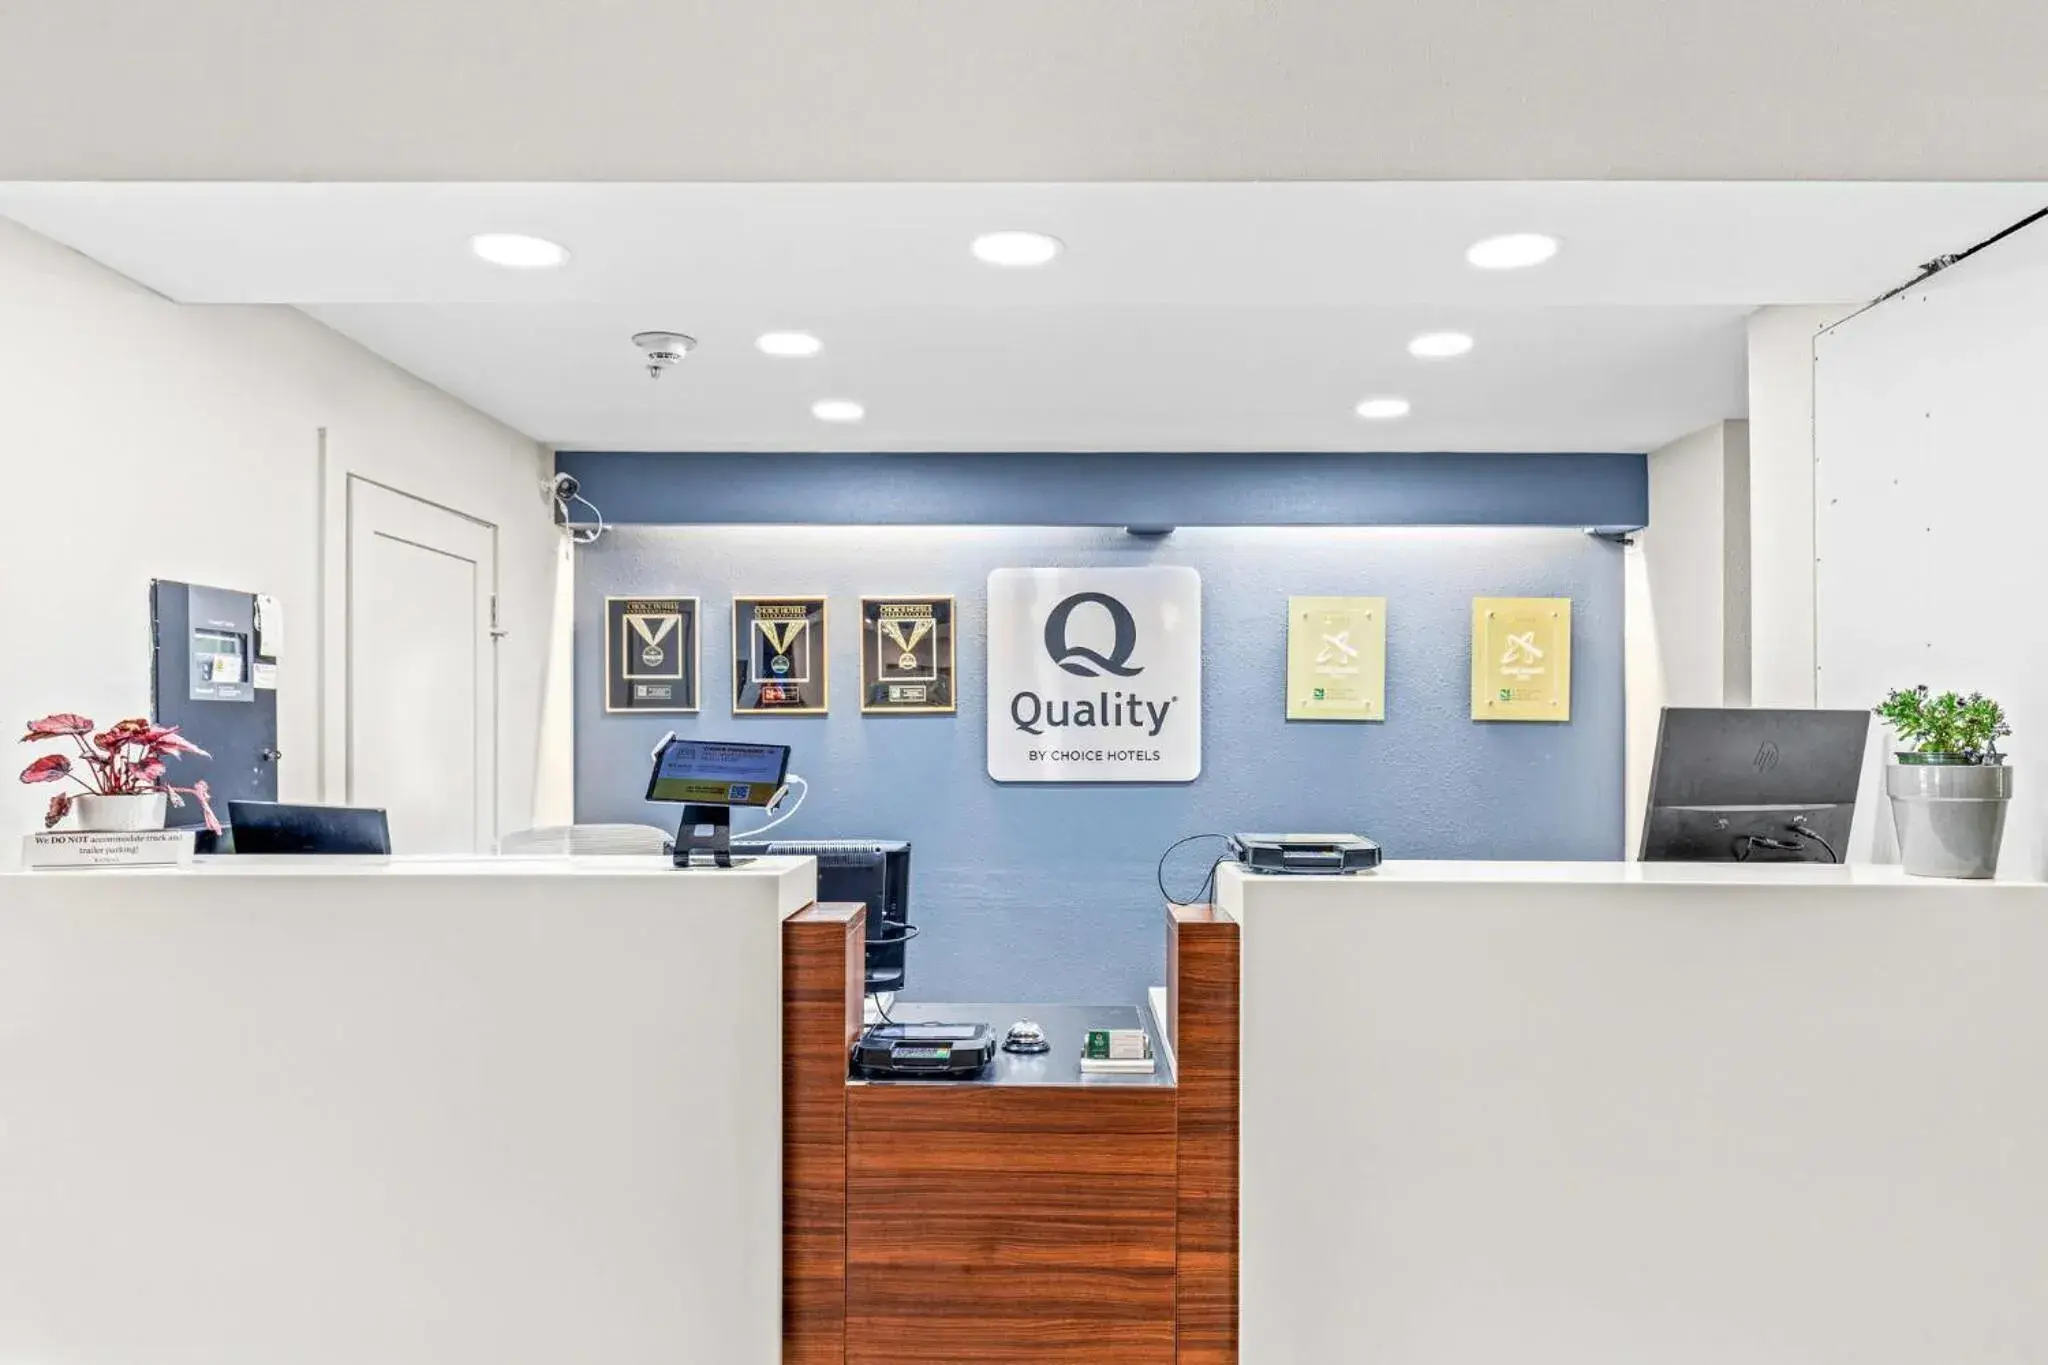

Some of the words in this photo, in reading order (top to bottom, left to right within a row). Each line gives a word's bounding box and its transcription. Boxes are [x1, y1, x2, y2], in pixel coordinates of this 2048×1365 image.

[1044, 592, 1145, 677] Q
[1011, 691, 1170, 737] Quality
[1029, 750, 1046, 761] BY
[1050, 750, 1103, 761] CHOICE
[1107, 750, 1161, 761] HOTELS
[35, 836, 49, 844] We
[51, 836, 66, 844] DO
[68, 836, 88, 844] NOT
